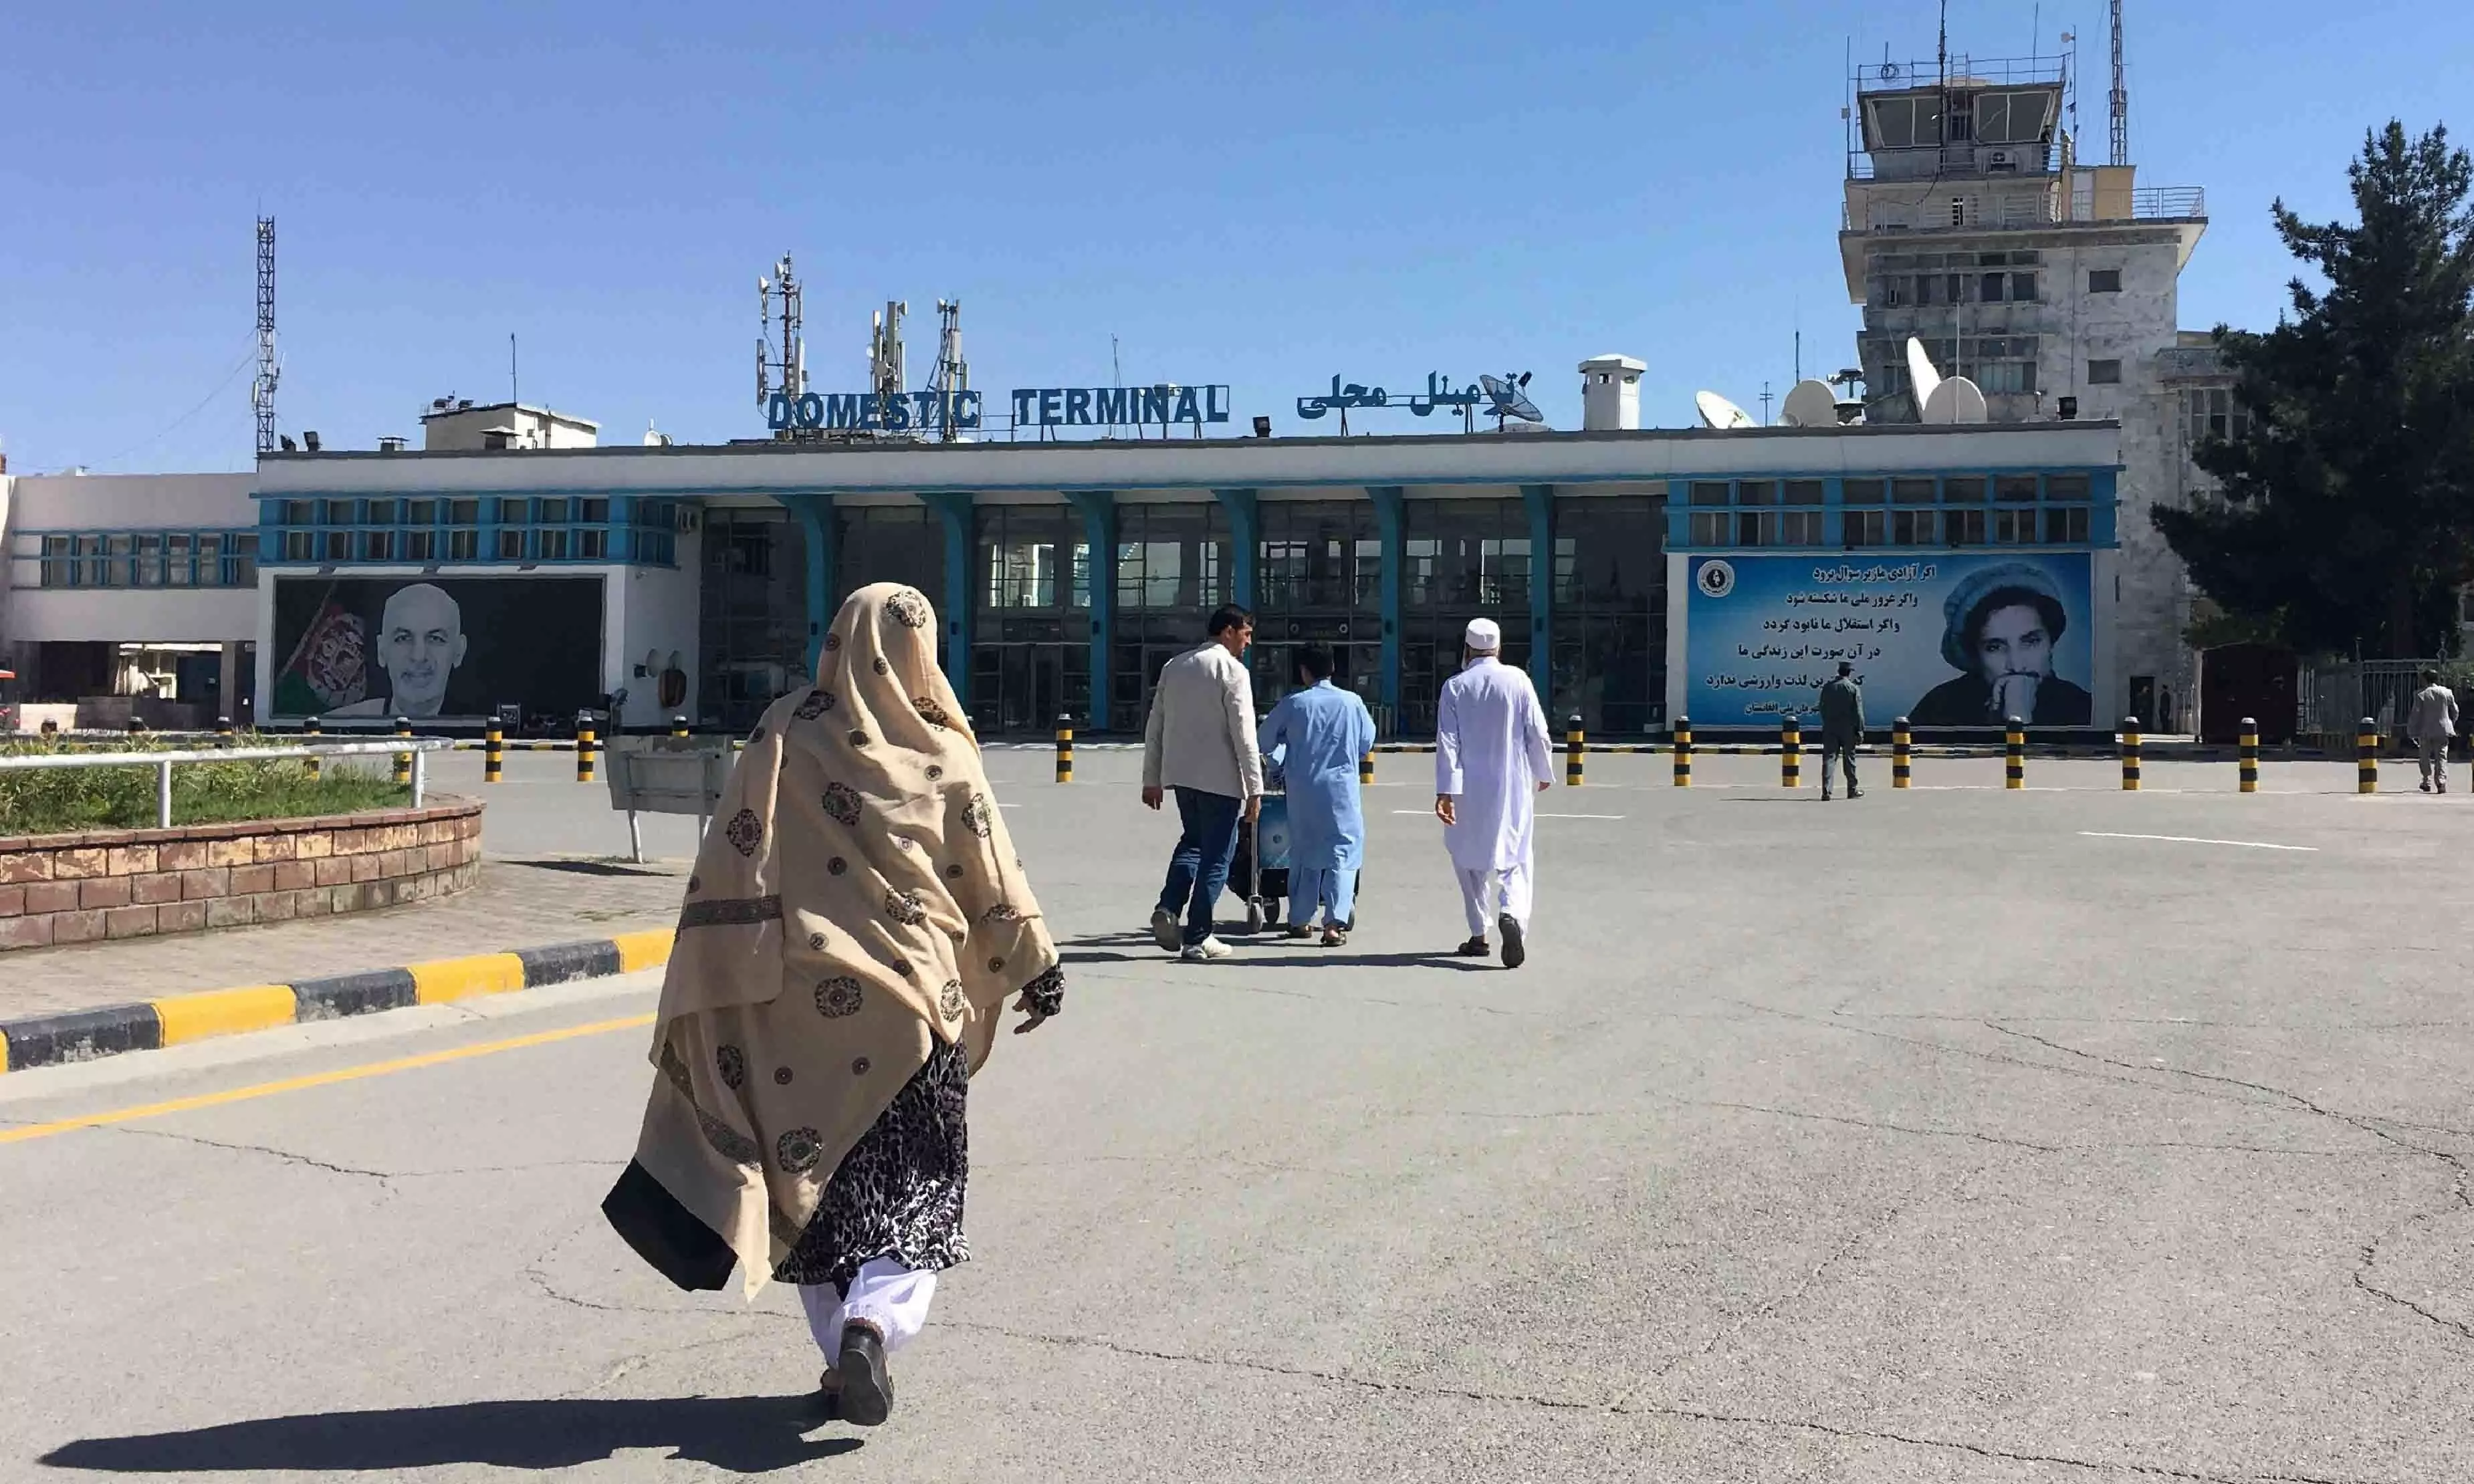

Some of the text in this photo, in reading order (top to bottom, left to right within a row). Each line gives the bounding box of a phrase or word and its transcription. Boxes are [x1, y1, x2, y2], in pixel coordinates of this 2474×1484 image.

[768, 385, 1229, 429] DOMESTIC TERMINAL
[1834, 618, 1874, 632] استقلال
[1738, 644, 1749, 656] ما
[1790, 644, 1809, 660] این
[1811, 646, 1845, 660] صورت
[1847, 644, 1864, 660] آن
[1867, 646, 1881, 660] در
